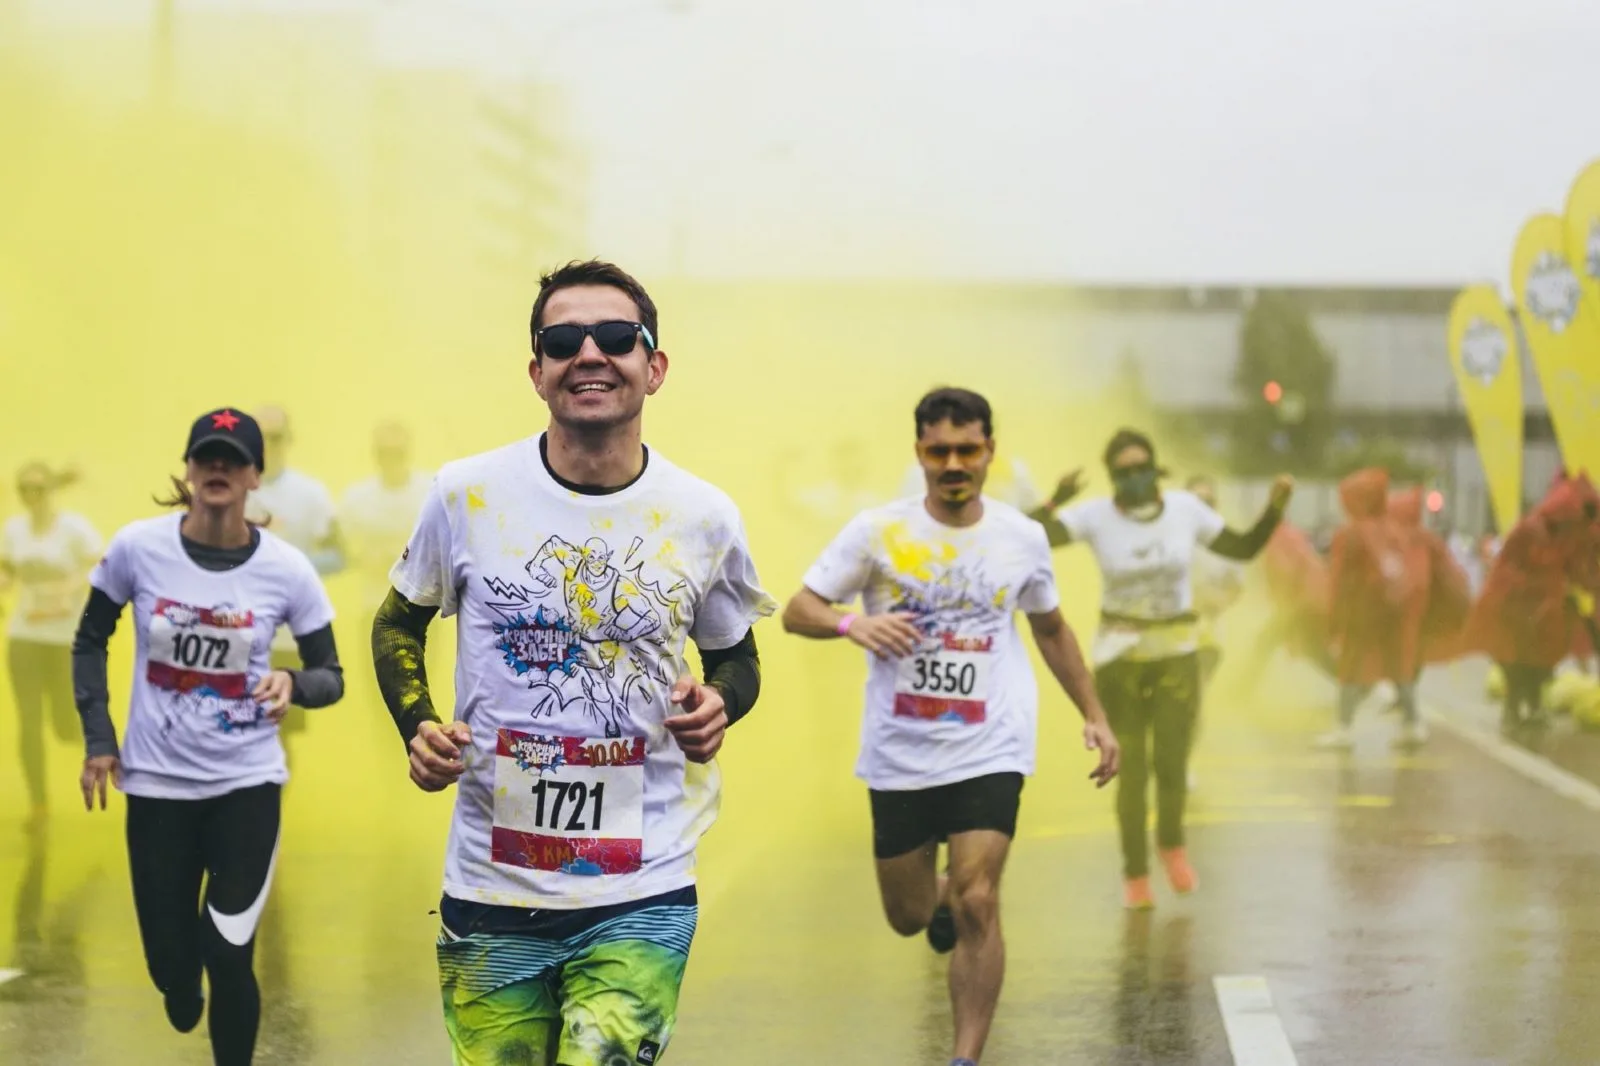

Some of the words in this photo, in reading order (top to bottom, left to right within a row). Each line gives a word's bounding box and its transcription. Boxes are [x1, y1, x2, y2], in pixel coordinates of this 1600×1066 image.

[505, 627, 581, 645] КРАСОЧНЫЙ
[172, 633, 230, 668] 1072
[517, 641, 567, 662] ЗАБЕГ
[912, 658, 975, 695] 3550
[525, 750, 556, 766] ЗАБЕГ
[532, 779, 604, 831] 1721
[527, 844, 538, 864] 5
